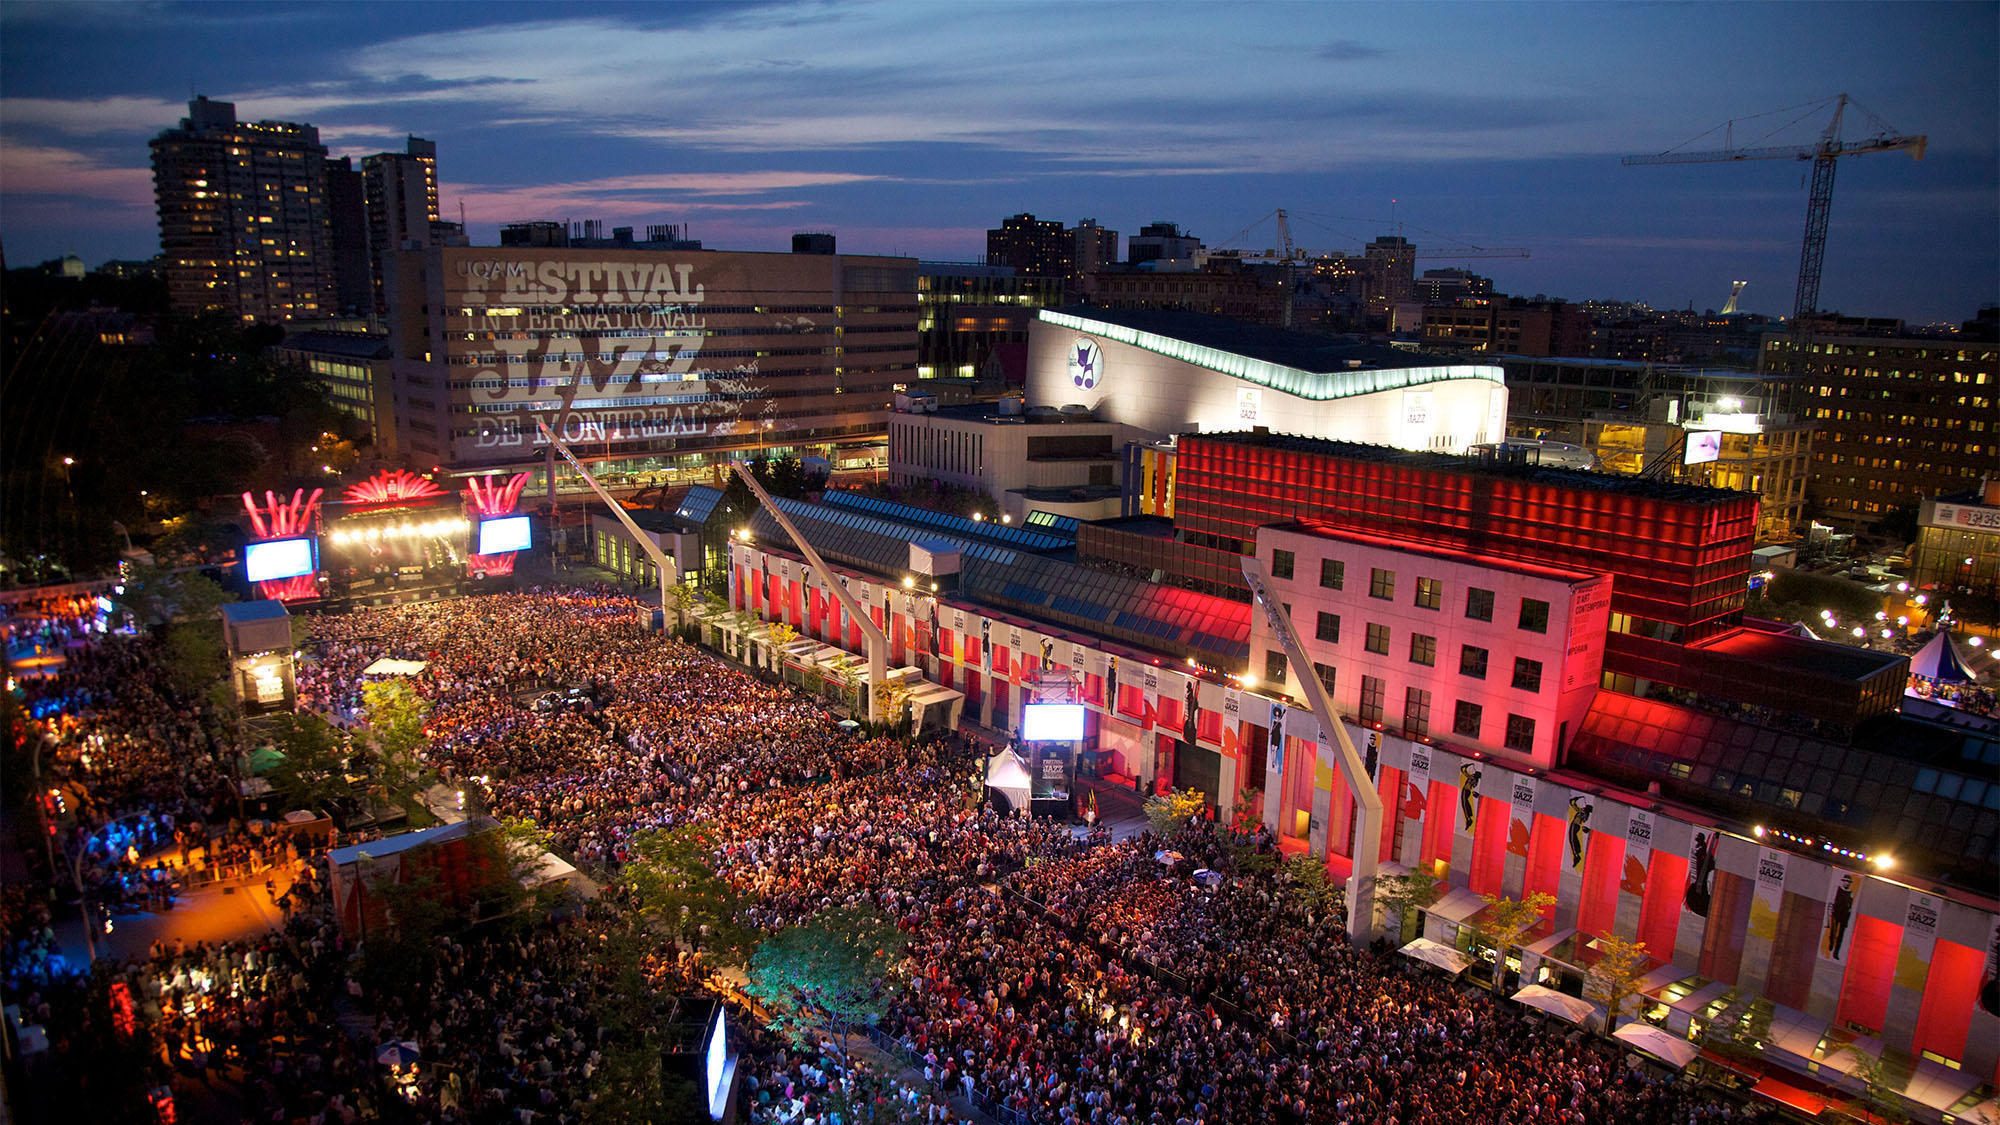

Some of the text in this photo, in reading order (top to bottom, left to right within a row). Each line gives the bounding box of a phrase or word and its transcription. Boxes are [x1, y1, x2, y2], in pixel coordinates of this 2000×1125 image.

[461, 261, 704, 303] FESTIVAL
[464, 303, 705, 331] INTERNATIONAL
[470, 336, 705, 412] JAZZ
[472, 415, 523, 448] DE
[1042, 764, 1064, 774] JAZZ
[1411, 759, 1430, 771] JAZZ
[1513, 791, 1533, 803] JAZZ
[1629, 826, 1650, 840] JAZZ
[1759, 866, 1784, 881] JAZZ
[1907, 911, 1937, 928] JAZZ
